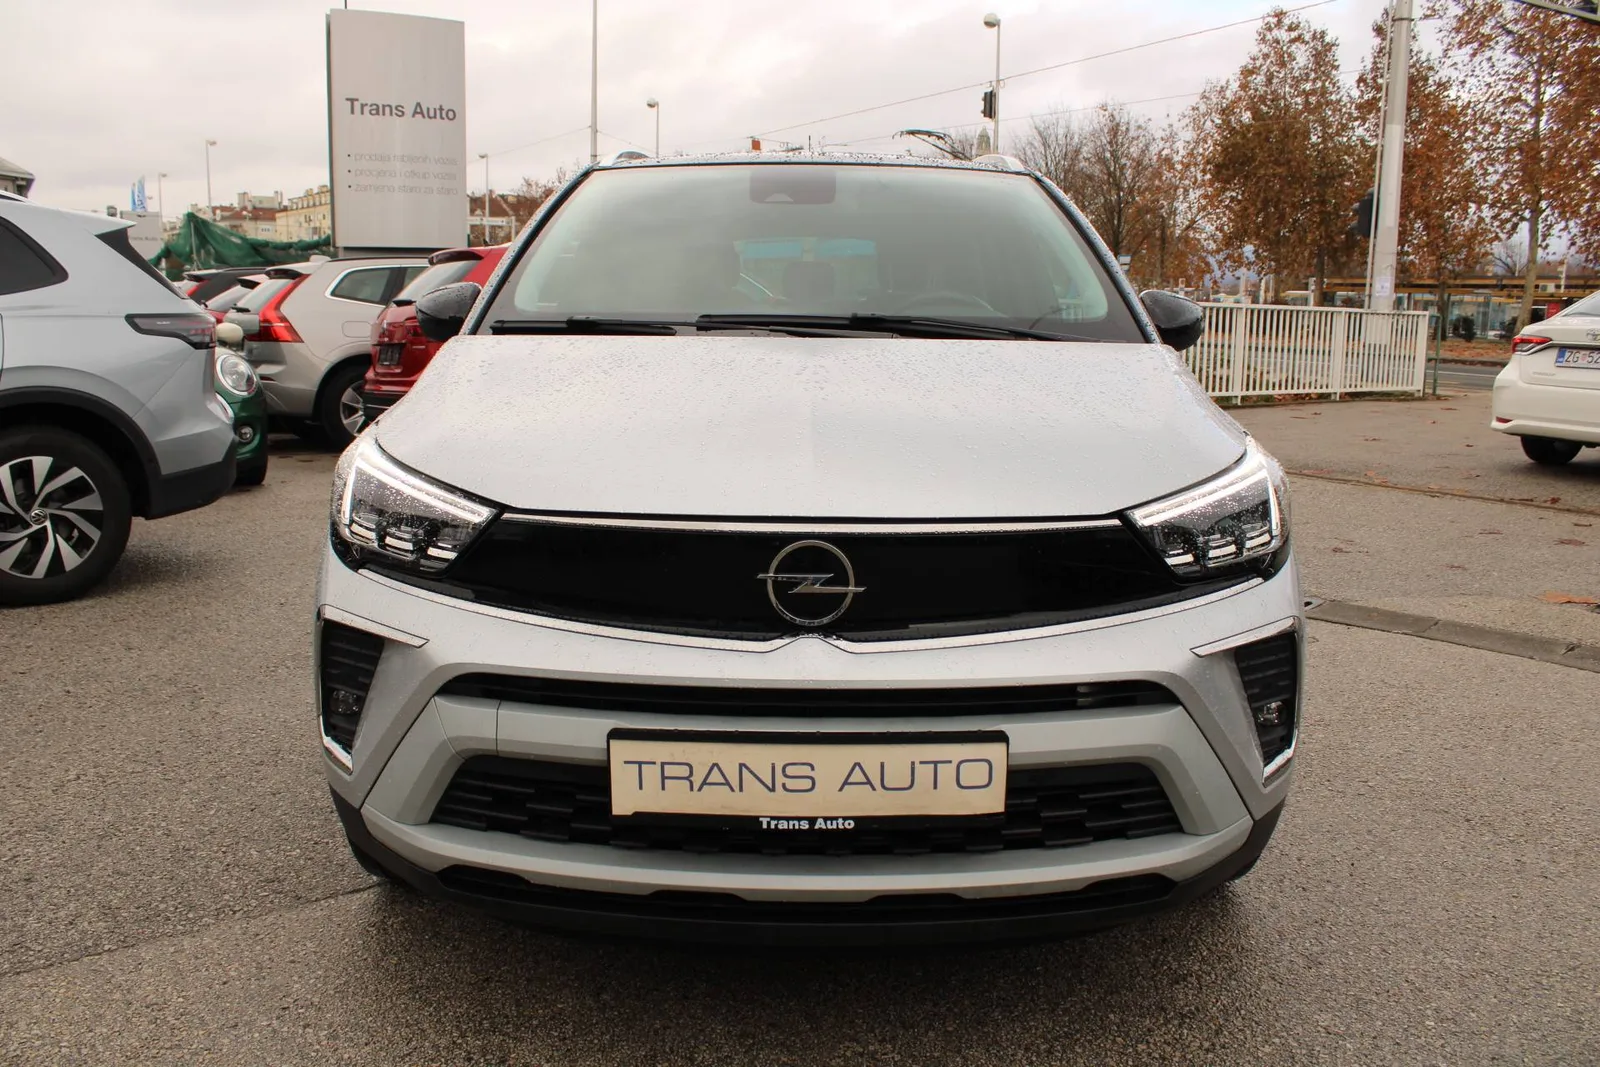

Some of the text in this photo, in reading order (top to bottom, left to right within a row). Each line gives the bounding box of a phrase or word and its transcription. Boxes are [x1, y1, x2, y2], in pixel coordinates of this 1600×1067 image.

[345, 97, 457, 121] Trans Auto
[1565, 350, 1580, 363] ZG
[623, 758, 993, 793] TRANS AUTO
[759, 817, 855, 829] Trans Auto
